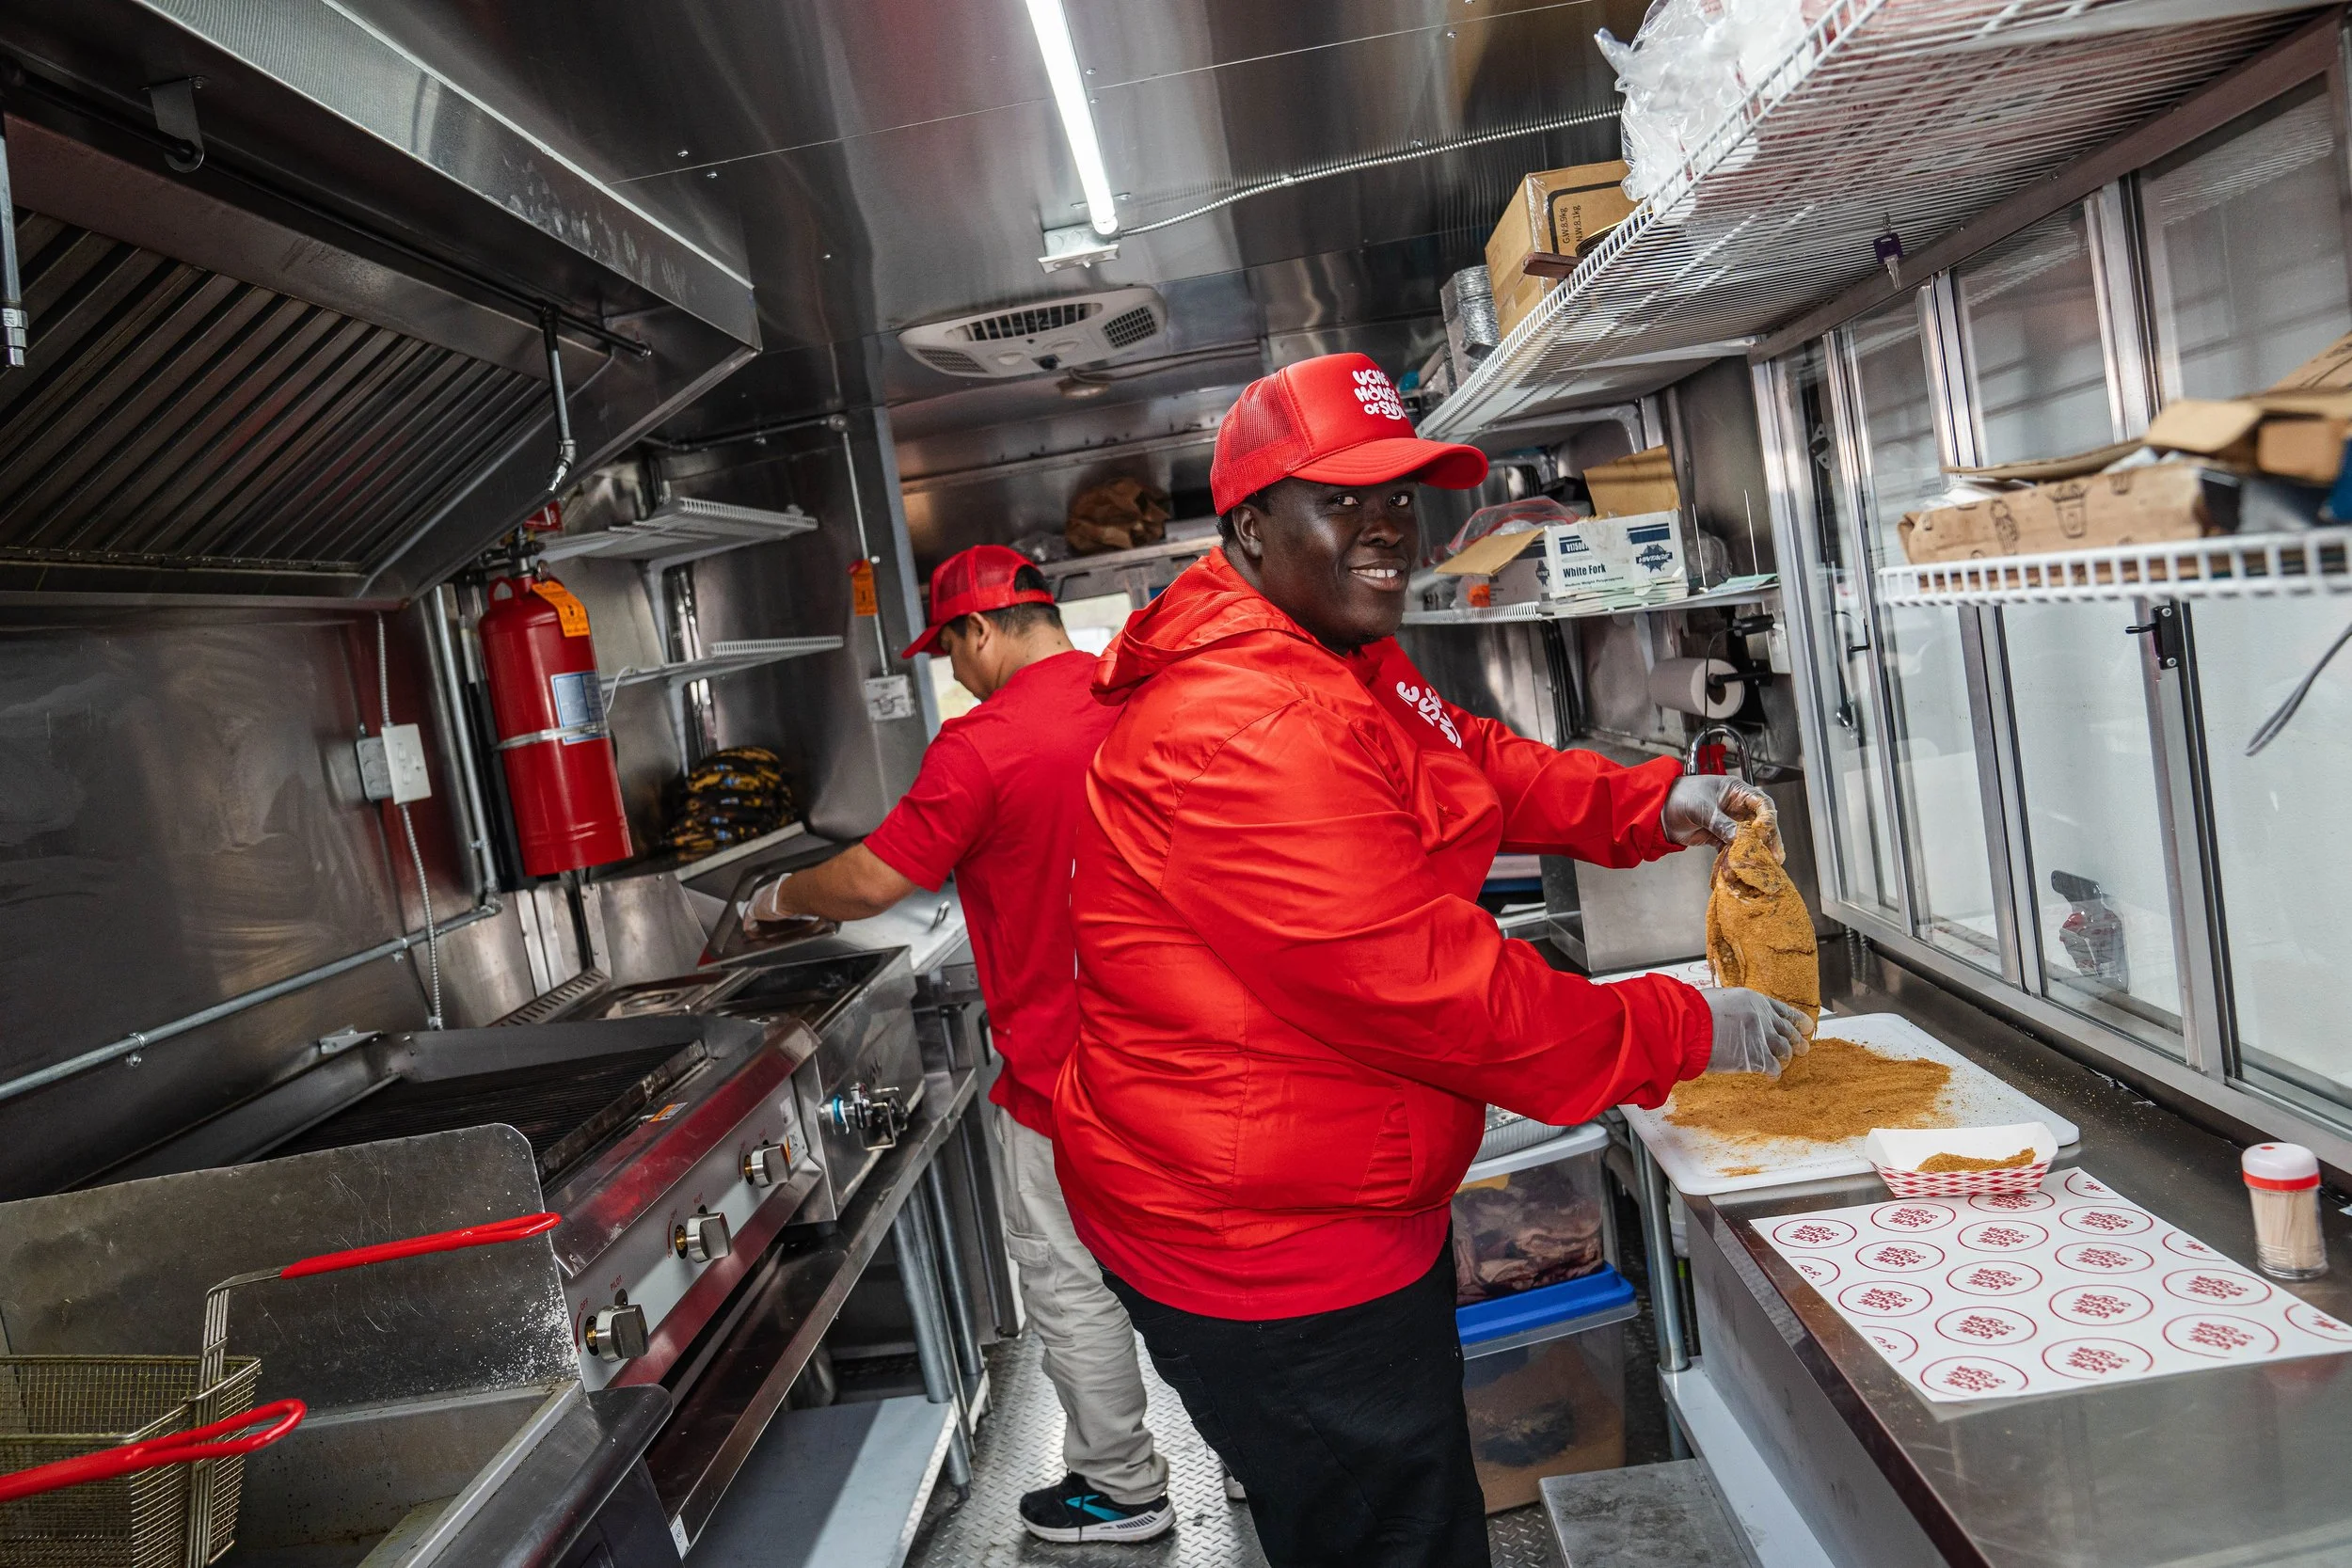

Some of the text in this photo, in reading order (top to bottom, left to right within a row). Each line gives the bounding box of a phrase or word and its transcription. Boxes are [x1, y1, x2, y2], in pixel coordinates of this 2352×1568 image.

[1563, 567, 1587, 578] White
[1588, 563, 1607, 575] Fork
[610, 1275, 624, 1291] PILOT
